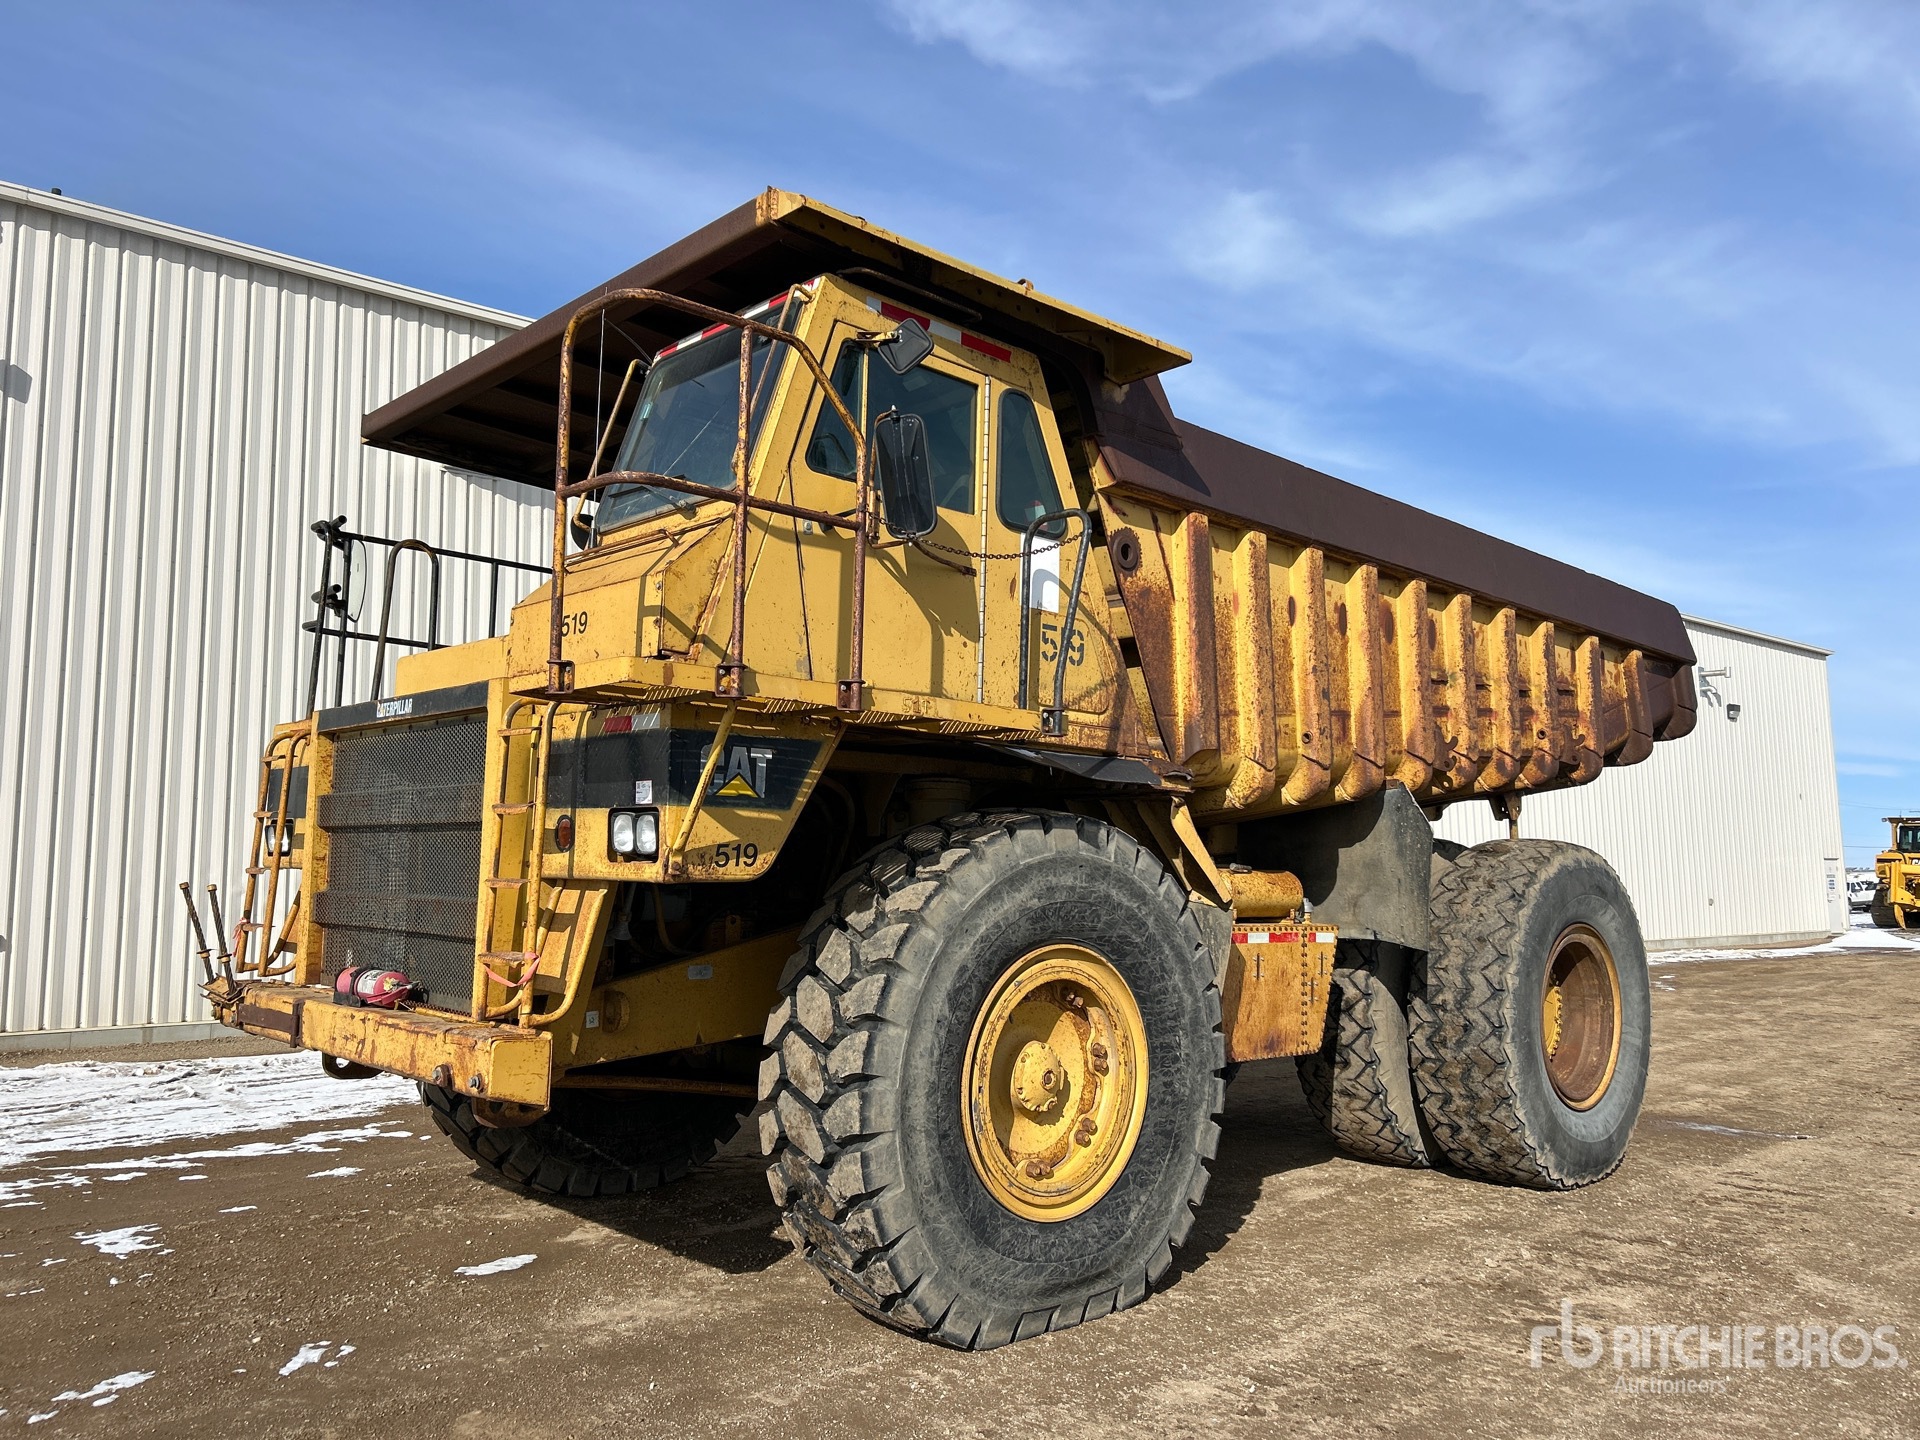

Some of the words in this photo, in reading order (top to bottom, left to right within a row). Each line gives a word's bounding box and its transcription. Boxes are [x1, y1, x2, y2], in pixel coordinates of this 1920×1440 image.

[562, 611, 588, 637] 519
[1041, 623, 1085, 667] 59
[376, 698, 413, 718] CATERPILLAR
[714, 842, 759, 868] 519
